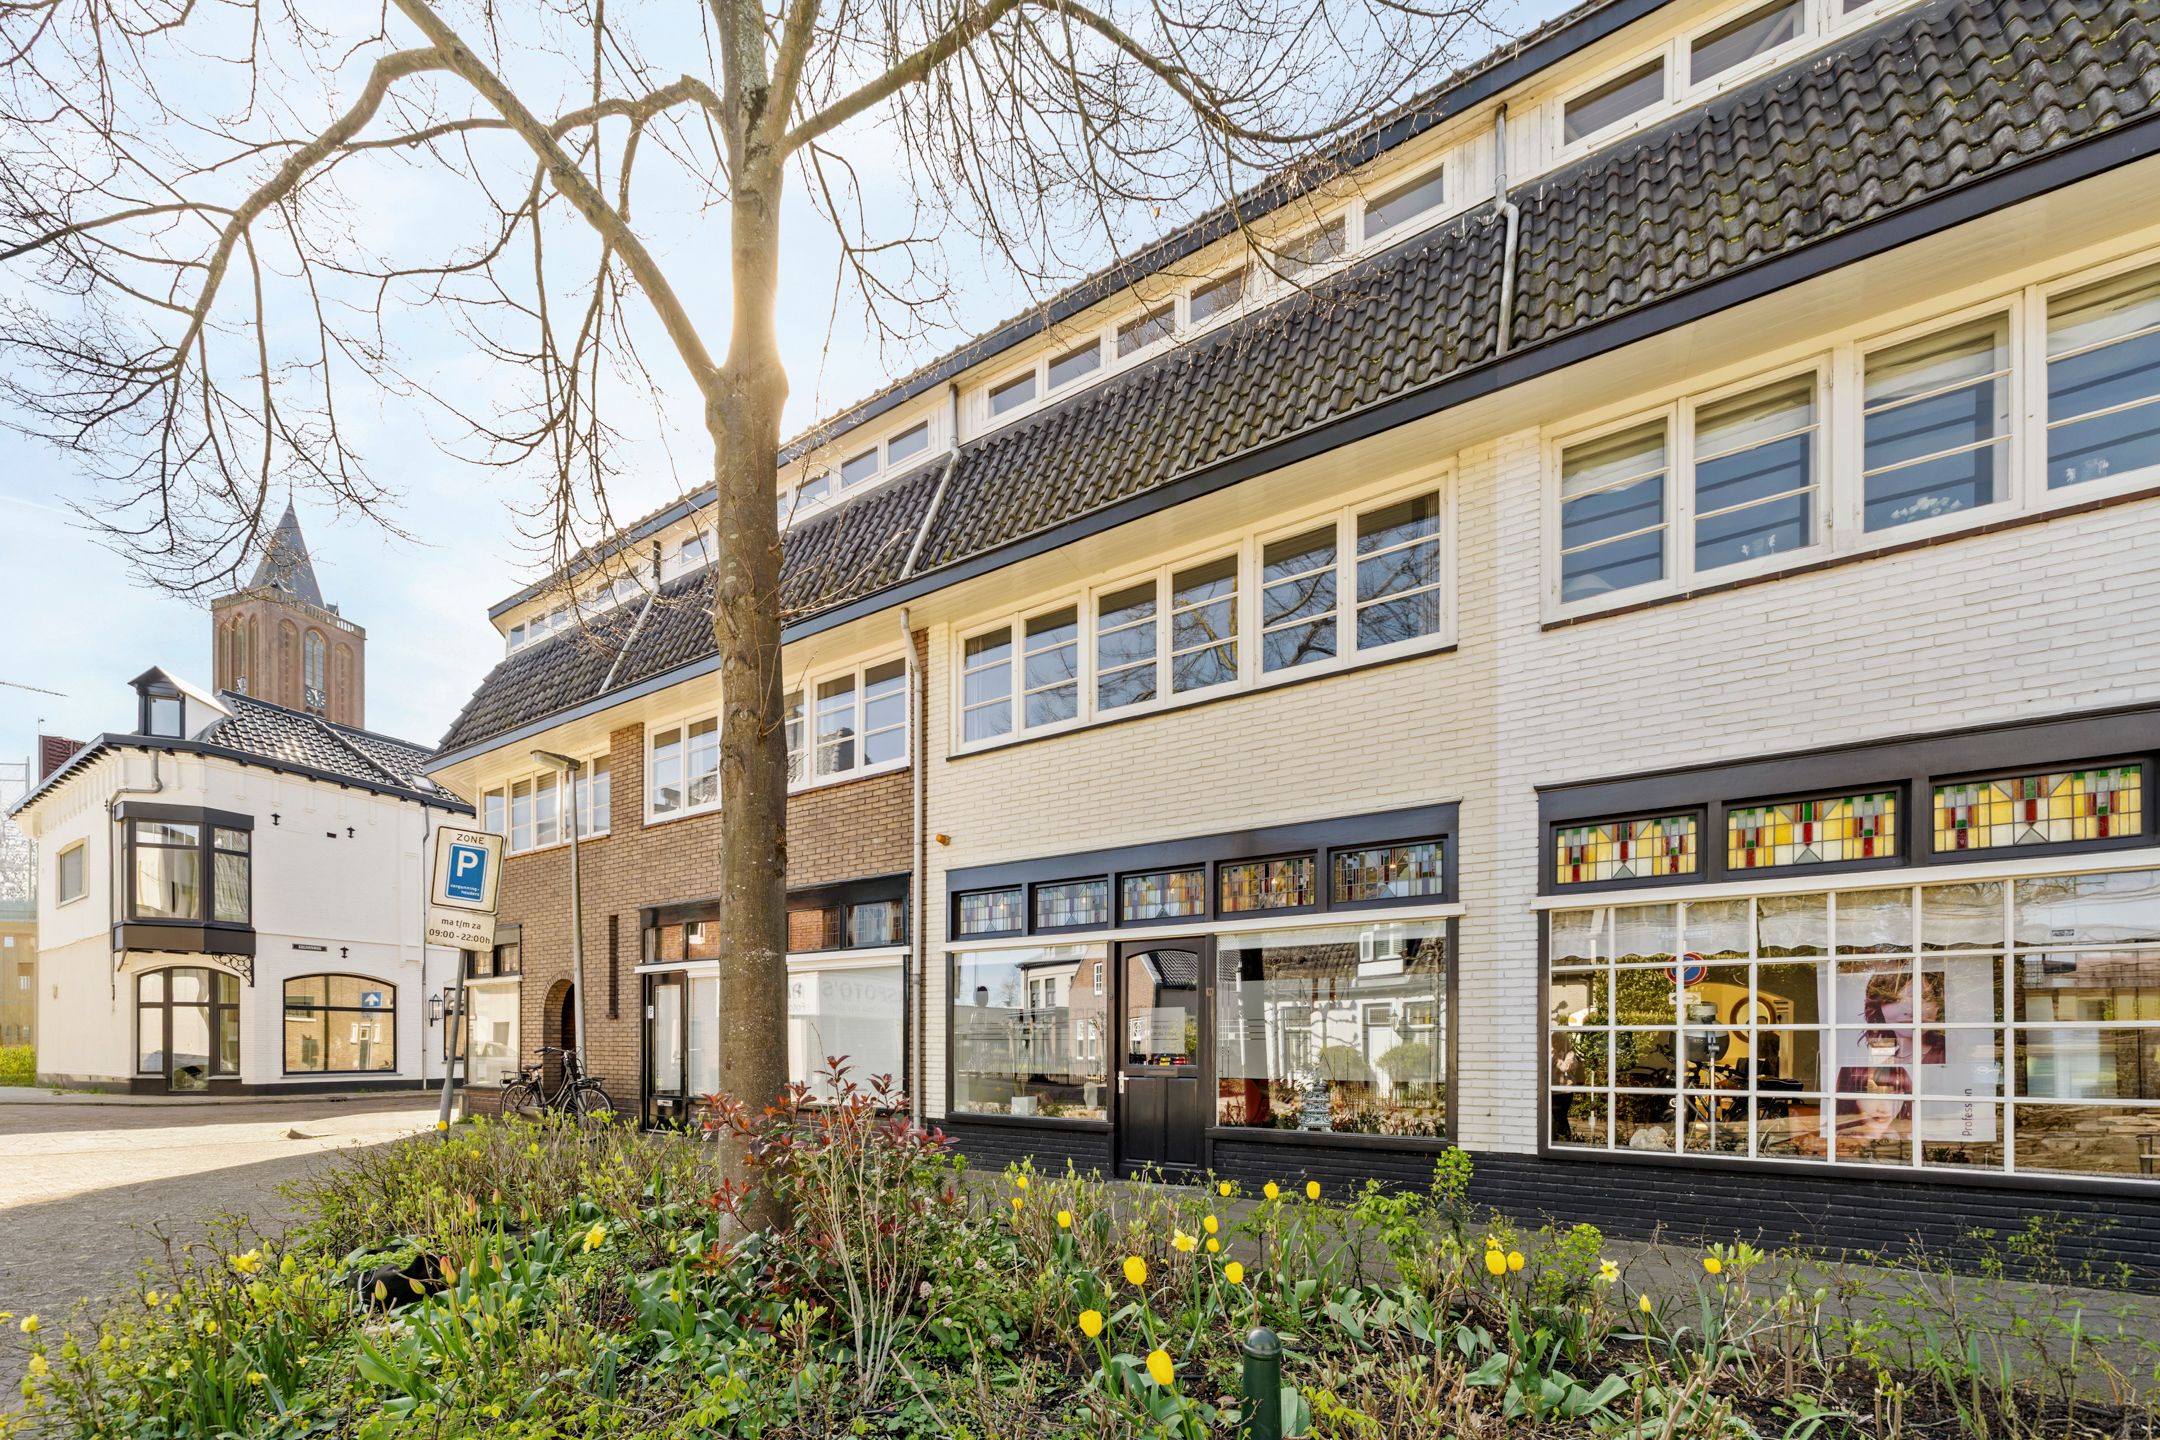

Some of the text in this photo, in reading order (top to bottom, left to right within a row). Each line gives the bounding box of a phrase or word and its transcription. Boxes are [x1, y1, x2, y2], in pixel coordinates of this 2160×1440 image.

[456, 833, 485, 845] ZONE
[456, 850, 479, 877] P
[456, 919, 470, 928] t/m
[428, 928, 455, 939] 09:00
[461, 933, 490, 944] 22:00h
[1961, 1088, 1973, 1137] Professn
